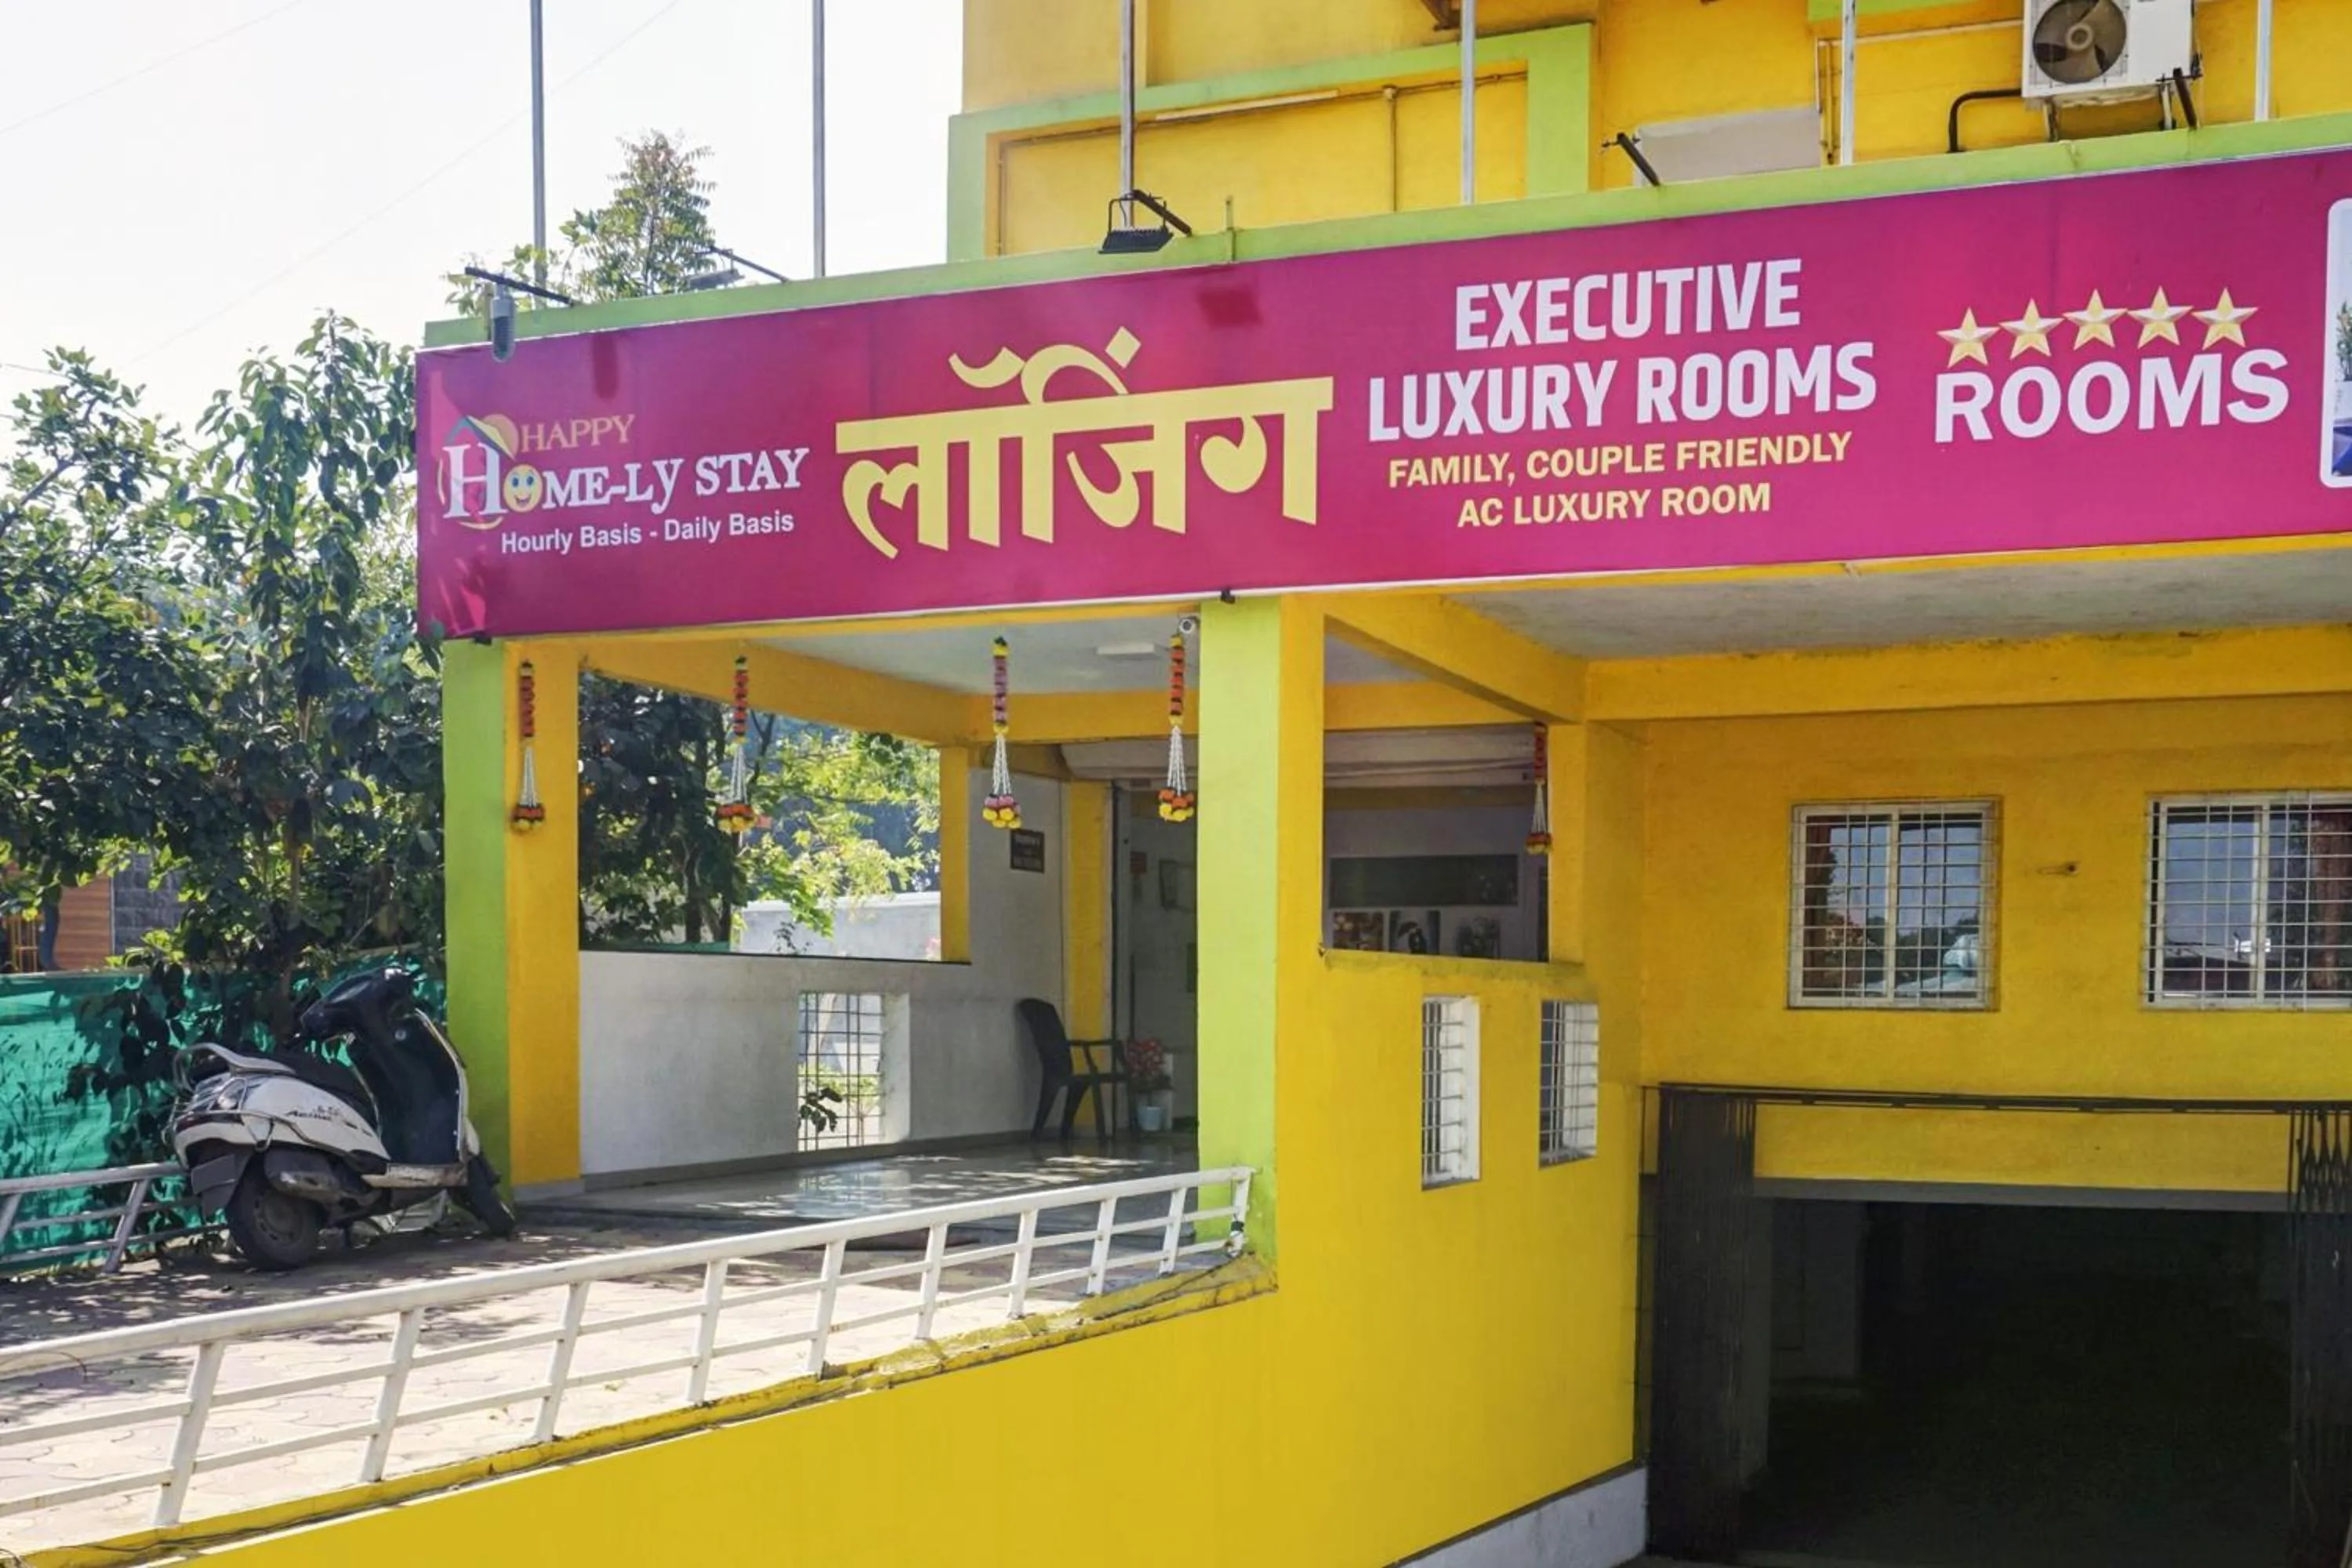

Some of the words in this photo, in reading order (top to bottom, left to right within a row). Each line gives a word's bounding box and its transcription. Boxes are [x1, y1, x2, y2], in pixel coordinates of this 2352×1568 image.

[1456, 258, 1802, 350] EXECUTIVE
[1369, 360, 1617, 441] LUXURY
[1636, 341, 1877, 424] ROOMS
[1935, 348, 2289, 443] ROOMS
[521, 414, 635, 452] HAPPY
[836, 326, 1334, 559] लॉजिंग
[1388, 452, 1515, 487] FAMILY,
[1526, 443, 1665, 479] COUPLE
[1676, 431, 1852, 471] FRIENDLY
[695, 448, 810, 496] STAY
[501, 528, 573, 555] Hourly
[580, 522, 642, 548] Basis
[664, 516, 722, 543] Daily
[728, 510, 794, 536] Basis
[1457, 497, 1503, 528] AC
[1514, 488, 1651, 524] LUXURY
[1661, 482, 1770, 517] ROOM
